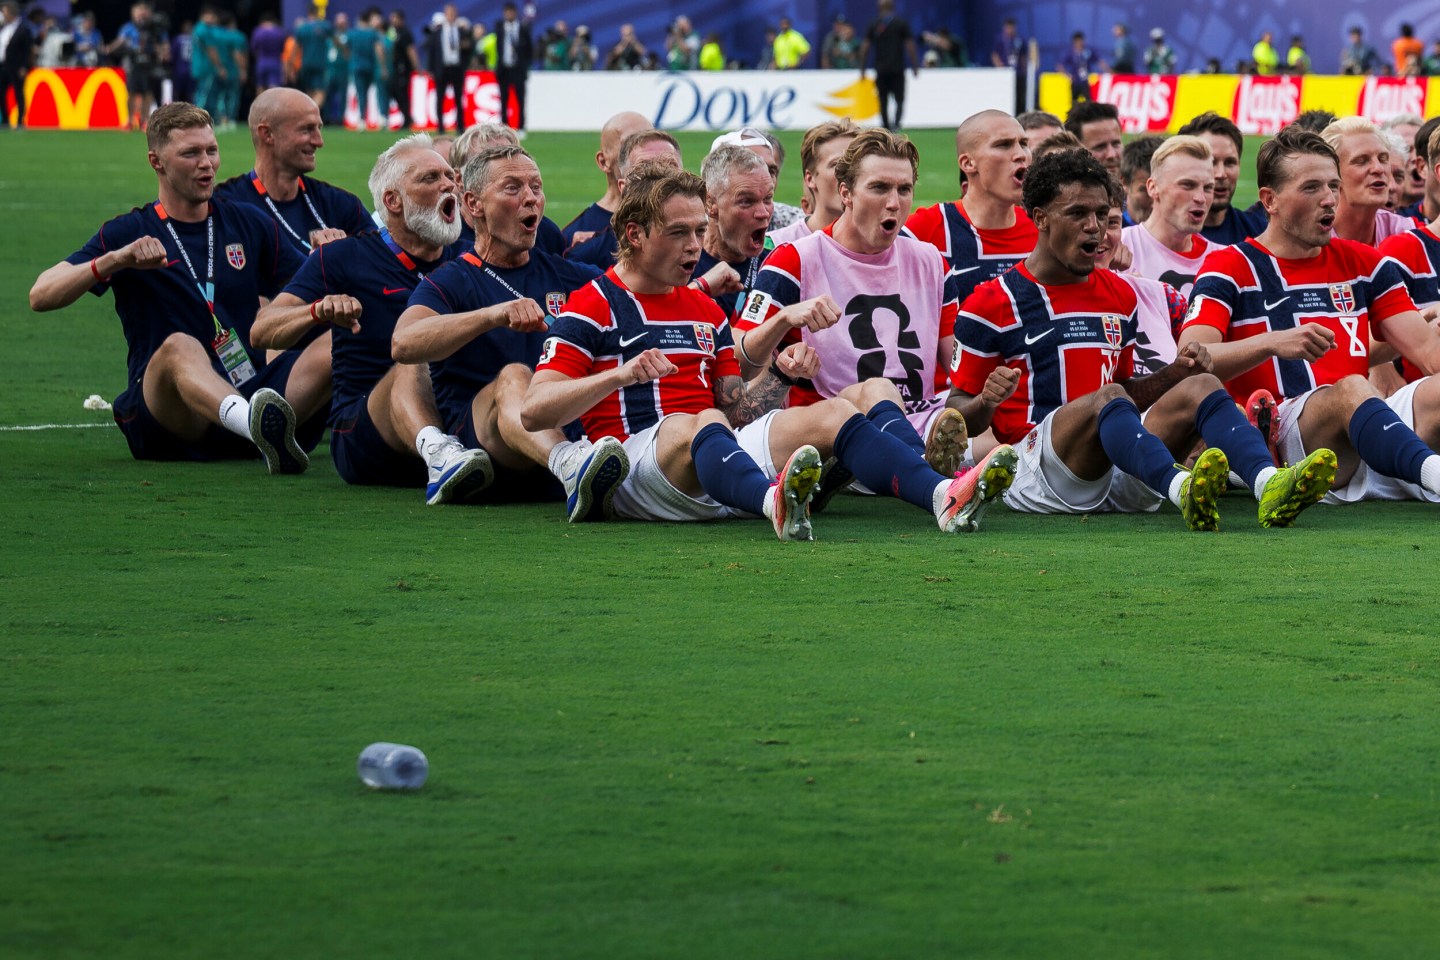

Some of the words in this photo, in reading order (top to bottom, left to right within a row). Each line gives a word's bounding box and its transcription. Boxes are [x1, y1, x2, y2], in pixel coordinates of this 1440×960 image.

[653, 71, 797, 130] Dove
[484, 267, 497, 278] FIFA
[495, 275, 514, 292] WORLD
[1338, 316, 1367, 358] 8
